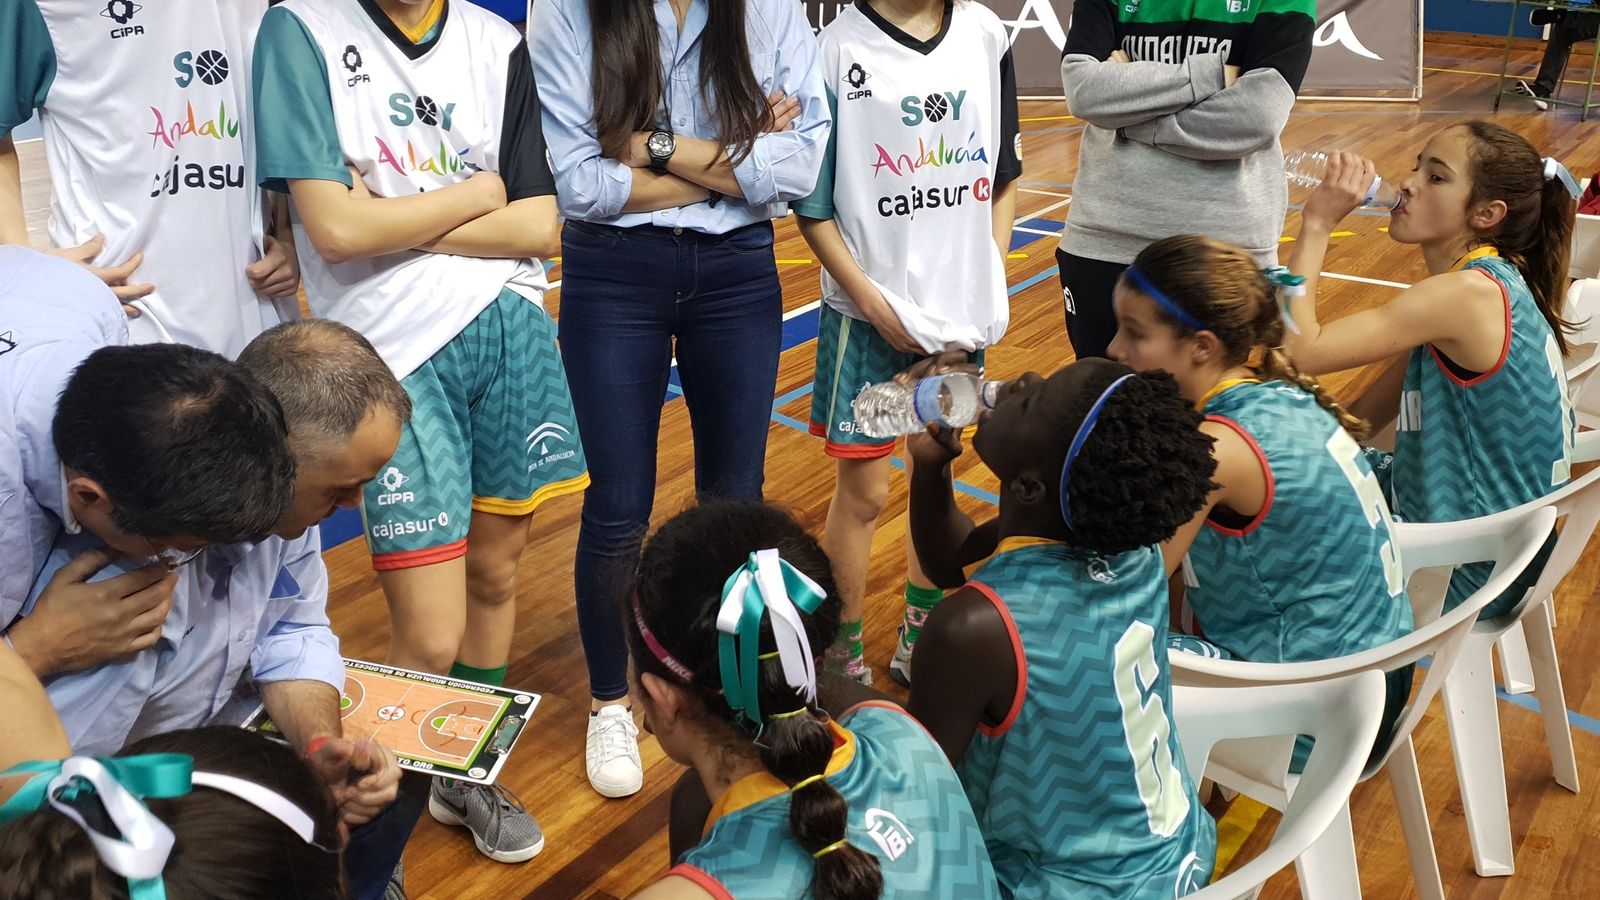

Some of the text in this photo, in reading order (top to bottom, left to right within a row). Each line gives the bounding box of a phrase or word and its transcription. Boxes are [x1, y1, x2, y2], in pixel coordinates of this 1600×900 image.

[870, 130, 989, 178] Andalucía
[372, 518, 437, 540] cajasur
[394, 668, 406, 677] DE
[1114, 620, 1190, 838] 6
